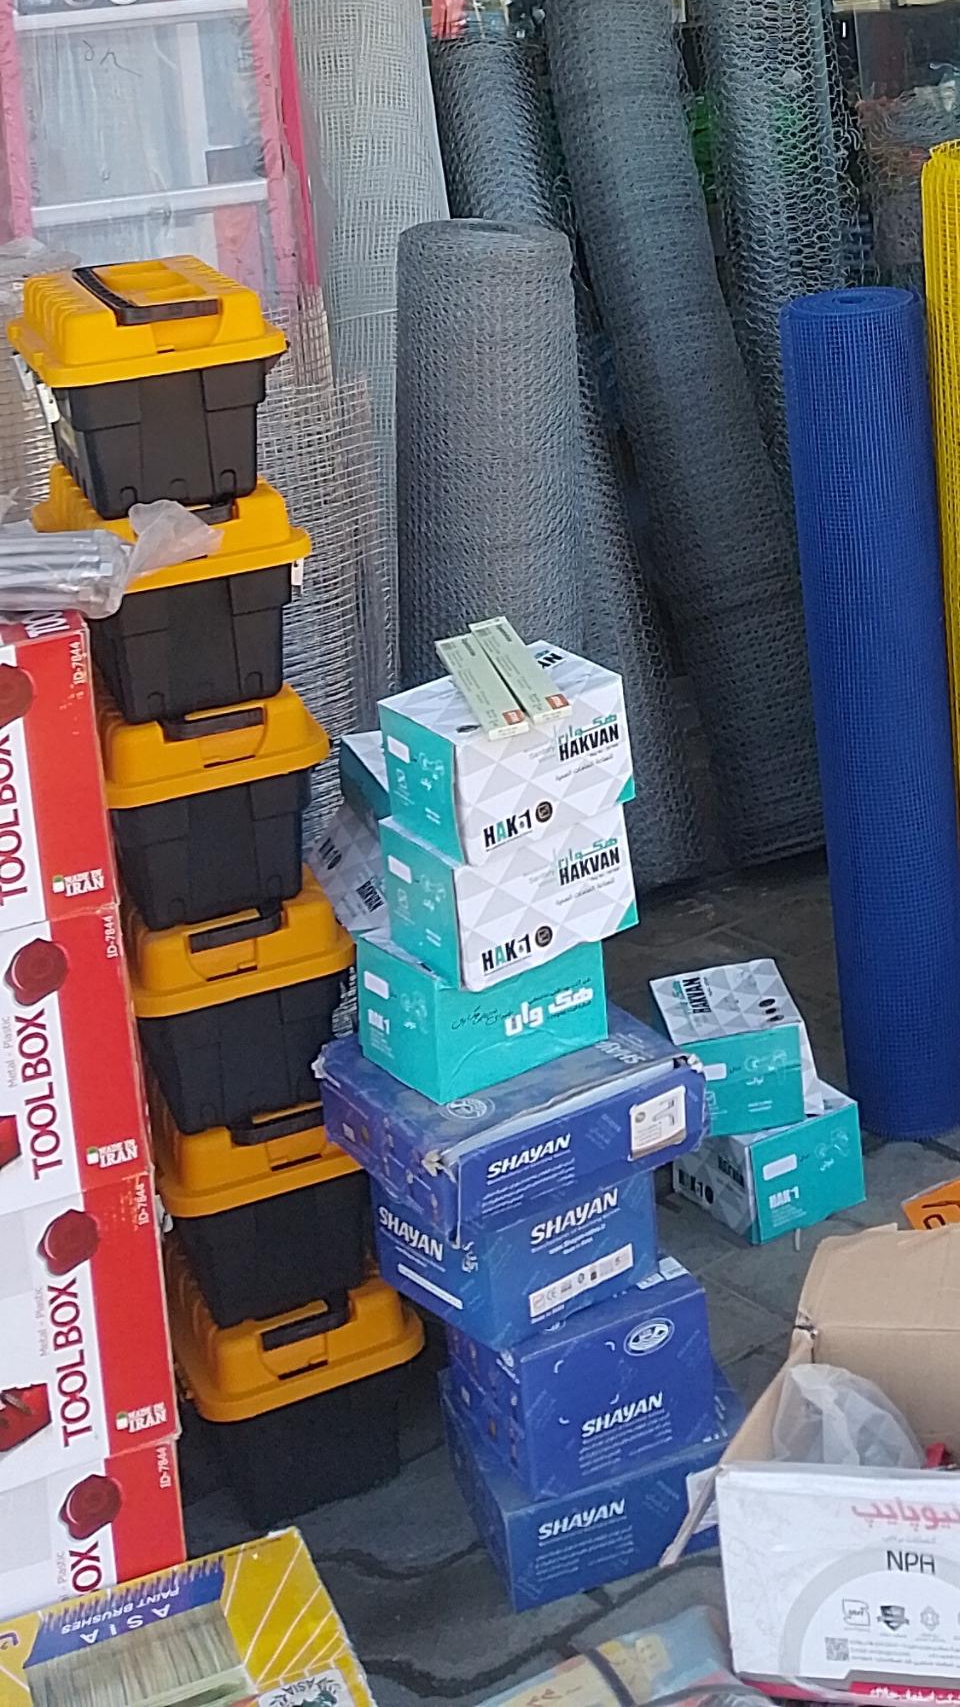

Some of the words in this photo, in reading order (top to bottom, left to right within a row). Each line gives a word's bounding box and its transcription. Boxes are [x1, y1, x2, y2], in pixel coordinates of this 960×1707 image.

[559, 723, 620, 762] HAKVAN
[65, 874, 105, 898] IRAN
[558, 846, 621, 887] HAKVAN
[103, 915, 119, 959] ID-7844
[503, 1001, 544, 1037] وان
[547, 986, 594, 1014] هک
[100, 1145, 138, 1169] IRAN
[486, 1133, 572, 1179] SHAYAN
[136, 1182, 151, 1226] ID-7844
[531, 1187, 619, 1245] SHAYAN
[378, 1205, 444, 1262] SHAYAN
[128, 1410, 168, 1434] IRAN
[581, 1391, 664, 1439] SHAYAN
[158, 1445, 172, 1489] ID-7844
[538, 1498, 626, 1541] SHAYAN
[134, 1586, 182, 1611] PAINT
[60, 1606, 133, 1636] BRUSHES
[80, 1603, 171, 1645] ASIA
